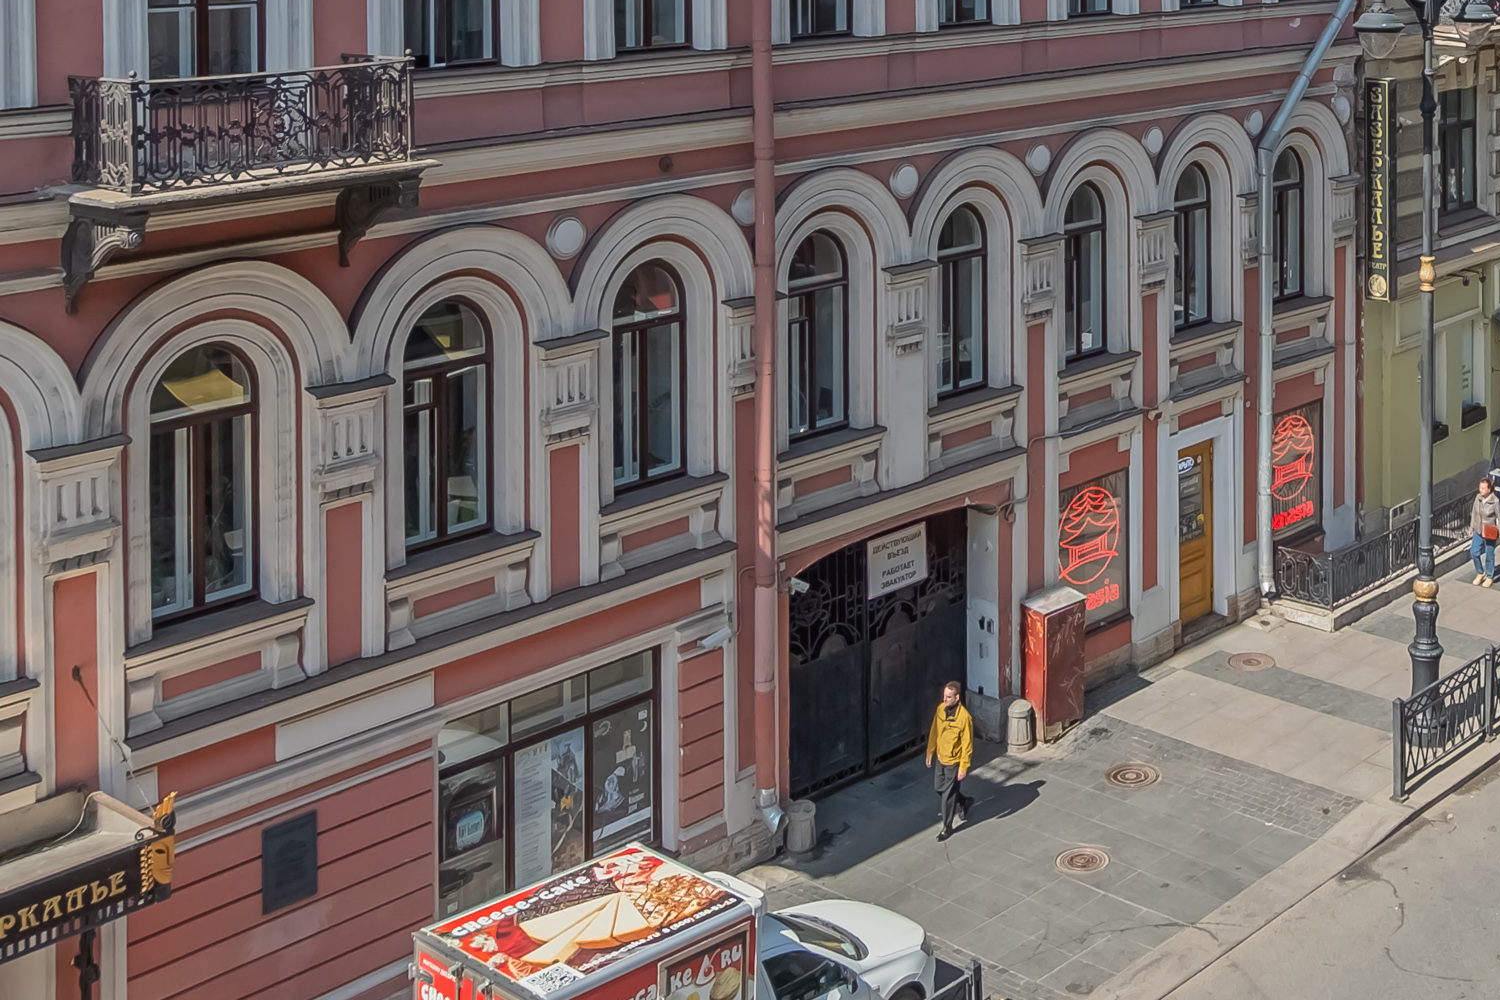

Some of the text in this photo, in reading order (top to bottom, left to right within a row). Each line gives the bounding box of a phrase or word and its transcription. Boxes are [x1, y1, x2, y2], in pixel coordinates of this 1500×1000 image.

[1369, 86, 1384, 259] ЗАЗЕРКАЛЬЕ
[872, 529, 922, 555] ДЕЙСТВУЮЩИЙ
[887, 546, 910, 560] ВЪЕЗД
[882, 560, 915, 578] РАБОТАЕТ
[880, 570, 917, 590] ЭВАКУАТОР
